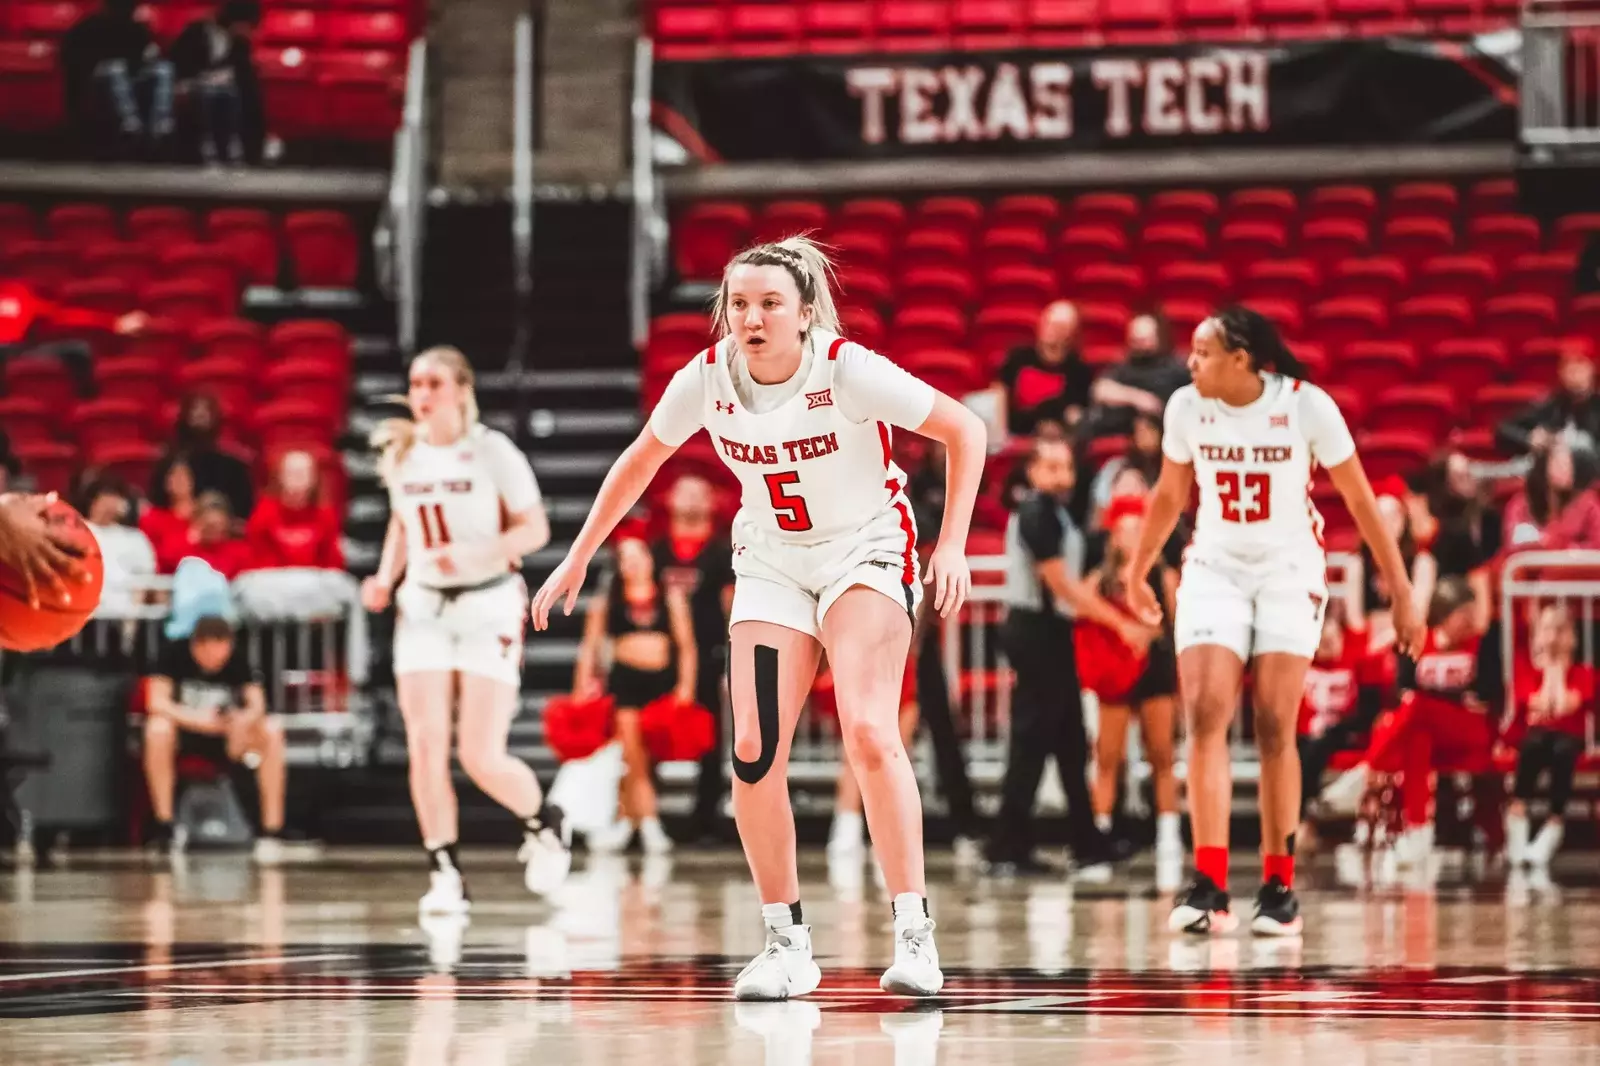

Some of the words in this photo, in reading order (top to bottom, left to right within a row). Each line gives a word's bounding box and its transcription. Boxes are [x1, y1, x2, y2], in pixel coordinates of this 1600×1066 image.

[846, 63, 1073, 143] TEXAS
[1091, 48, 1270, 138] TECH
[719, 435, 779, 464] TEXAS
[782, 432, 839, 462] TECH
[1252, 445, 1292, 463] TECH
[762, 470, 813, 532] 5
[1215, 470, 1271, 524] 23
[417, 503, 452, 549] 11
